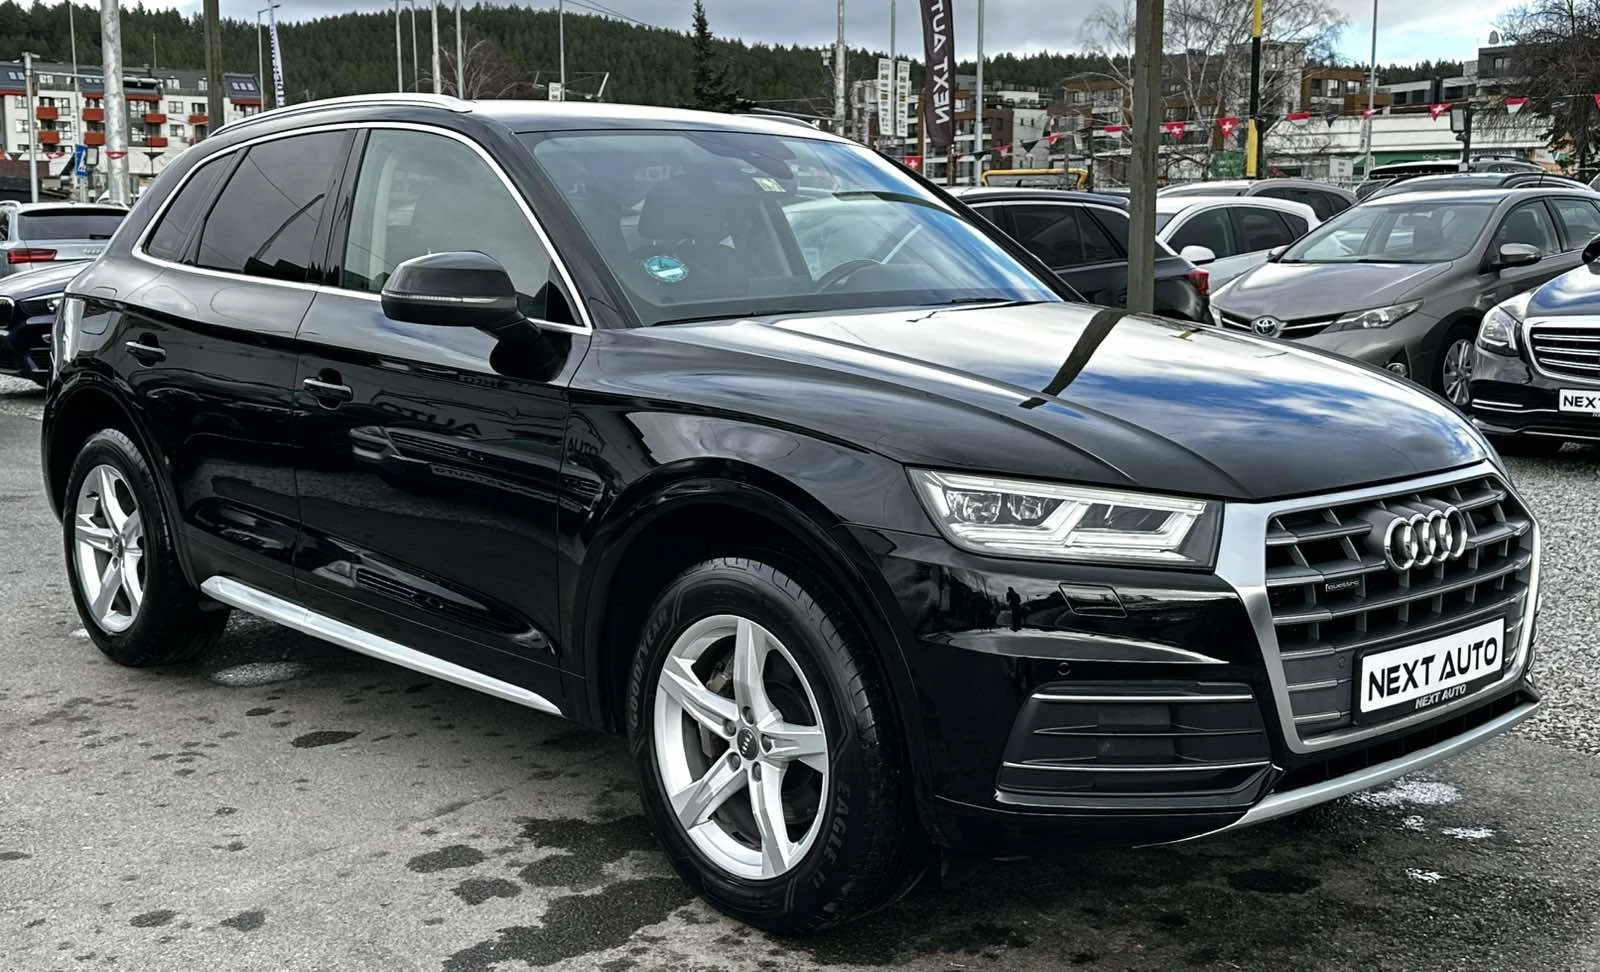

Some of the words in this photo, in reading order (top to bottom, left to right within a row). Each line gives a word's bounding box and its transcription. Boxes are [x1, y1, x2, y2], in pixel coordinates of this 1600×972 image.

[1564, 395, 1600, 408] NEX
[1368, 654, 1436, 701] NEXT
[1438, 636, 1498, 682] AUTO
[1415, 692, 1441, 709] NEXT
[1441, 684, 1467, 701] AUTO
